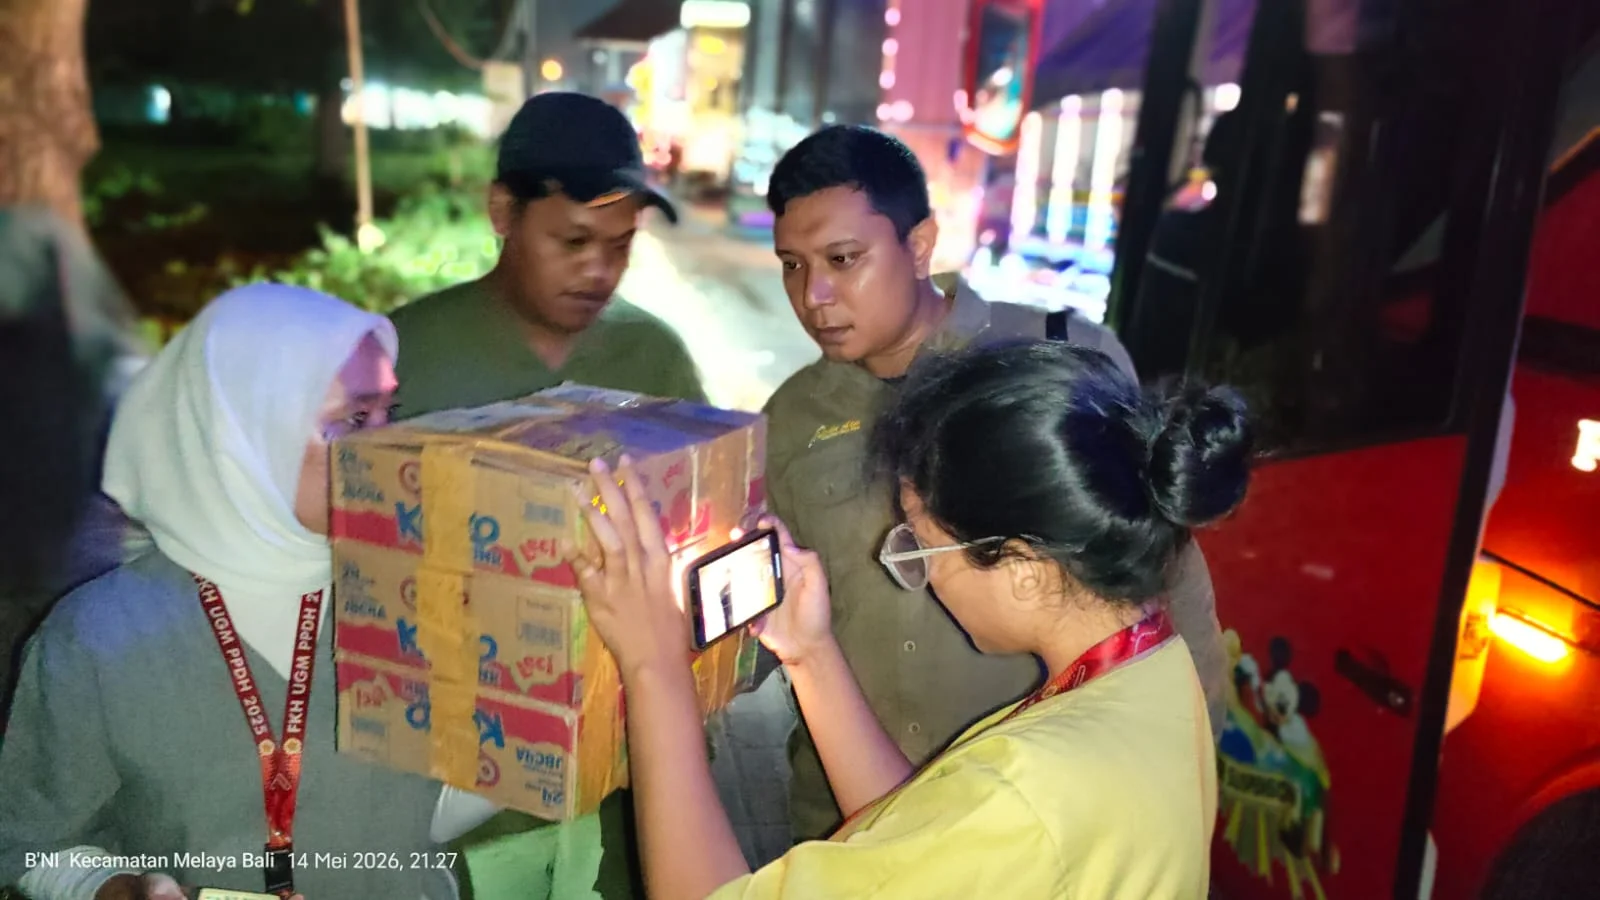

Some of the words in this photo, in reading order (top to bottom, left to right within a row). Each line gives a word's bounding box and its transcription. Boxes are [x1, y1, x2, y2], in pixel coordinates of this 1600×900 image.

[299, 607, 317, 650] PPDH
[209, 606, 235, 646] UGM
[226, 647, 252, 693] PPDH
[244, 696, 268, 736] 2025
[291, 655, 310, 695] UGM
[287, 700, 304, 733] FKH
